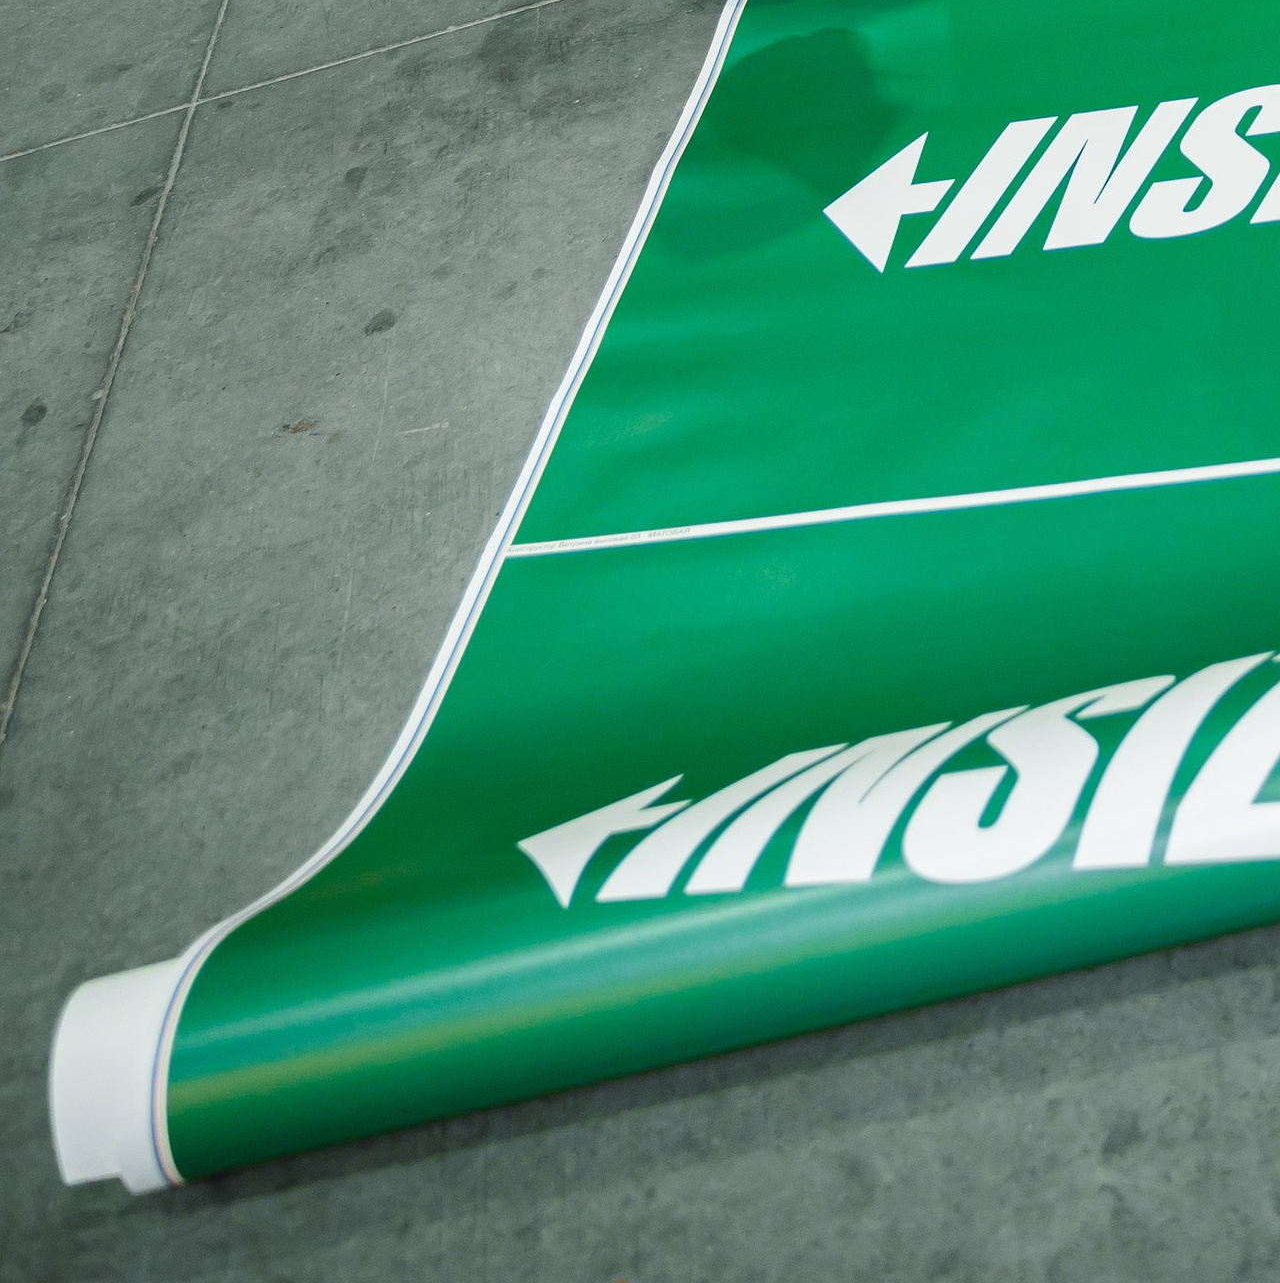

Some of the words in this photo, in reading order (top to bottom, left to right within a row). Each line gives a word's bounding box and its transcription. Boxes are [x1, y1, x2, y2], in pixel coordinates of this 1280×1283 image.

[507, 542, 557, 554] Конструктор
[558, 538, 593, 550] Витрина
[594, 535, 629, 546] высокая
[647, 527, 691, 539] МАТОВАЯ
